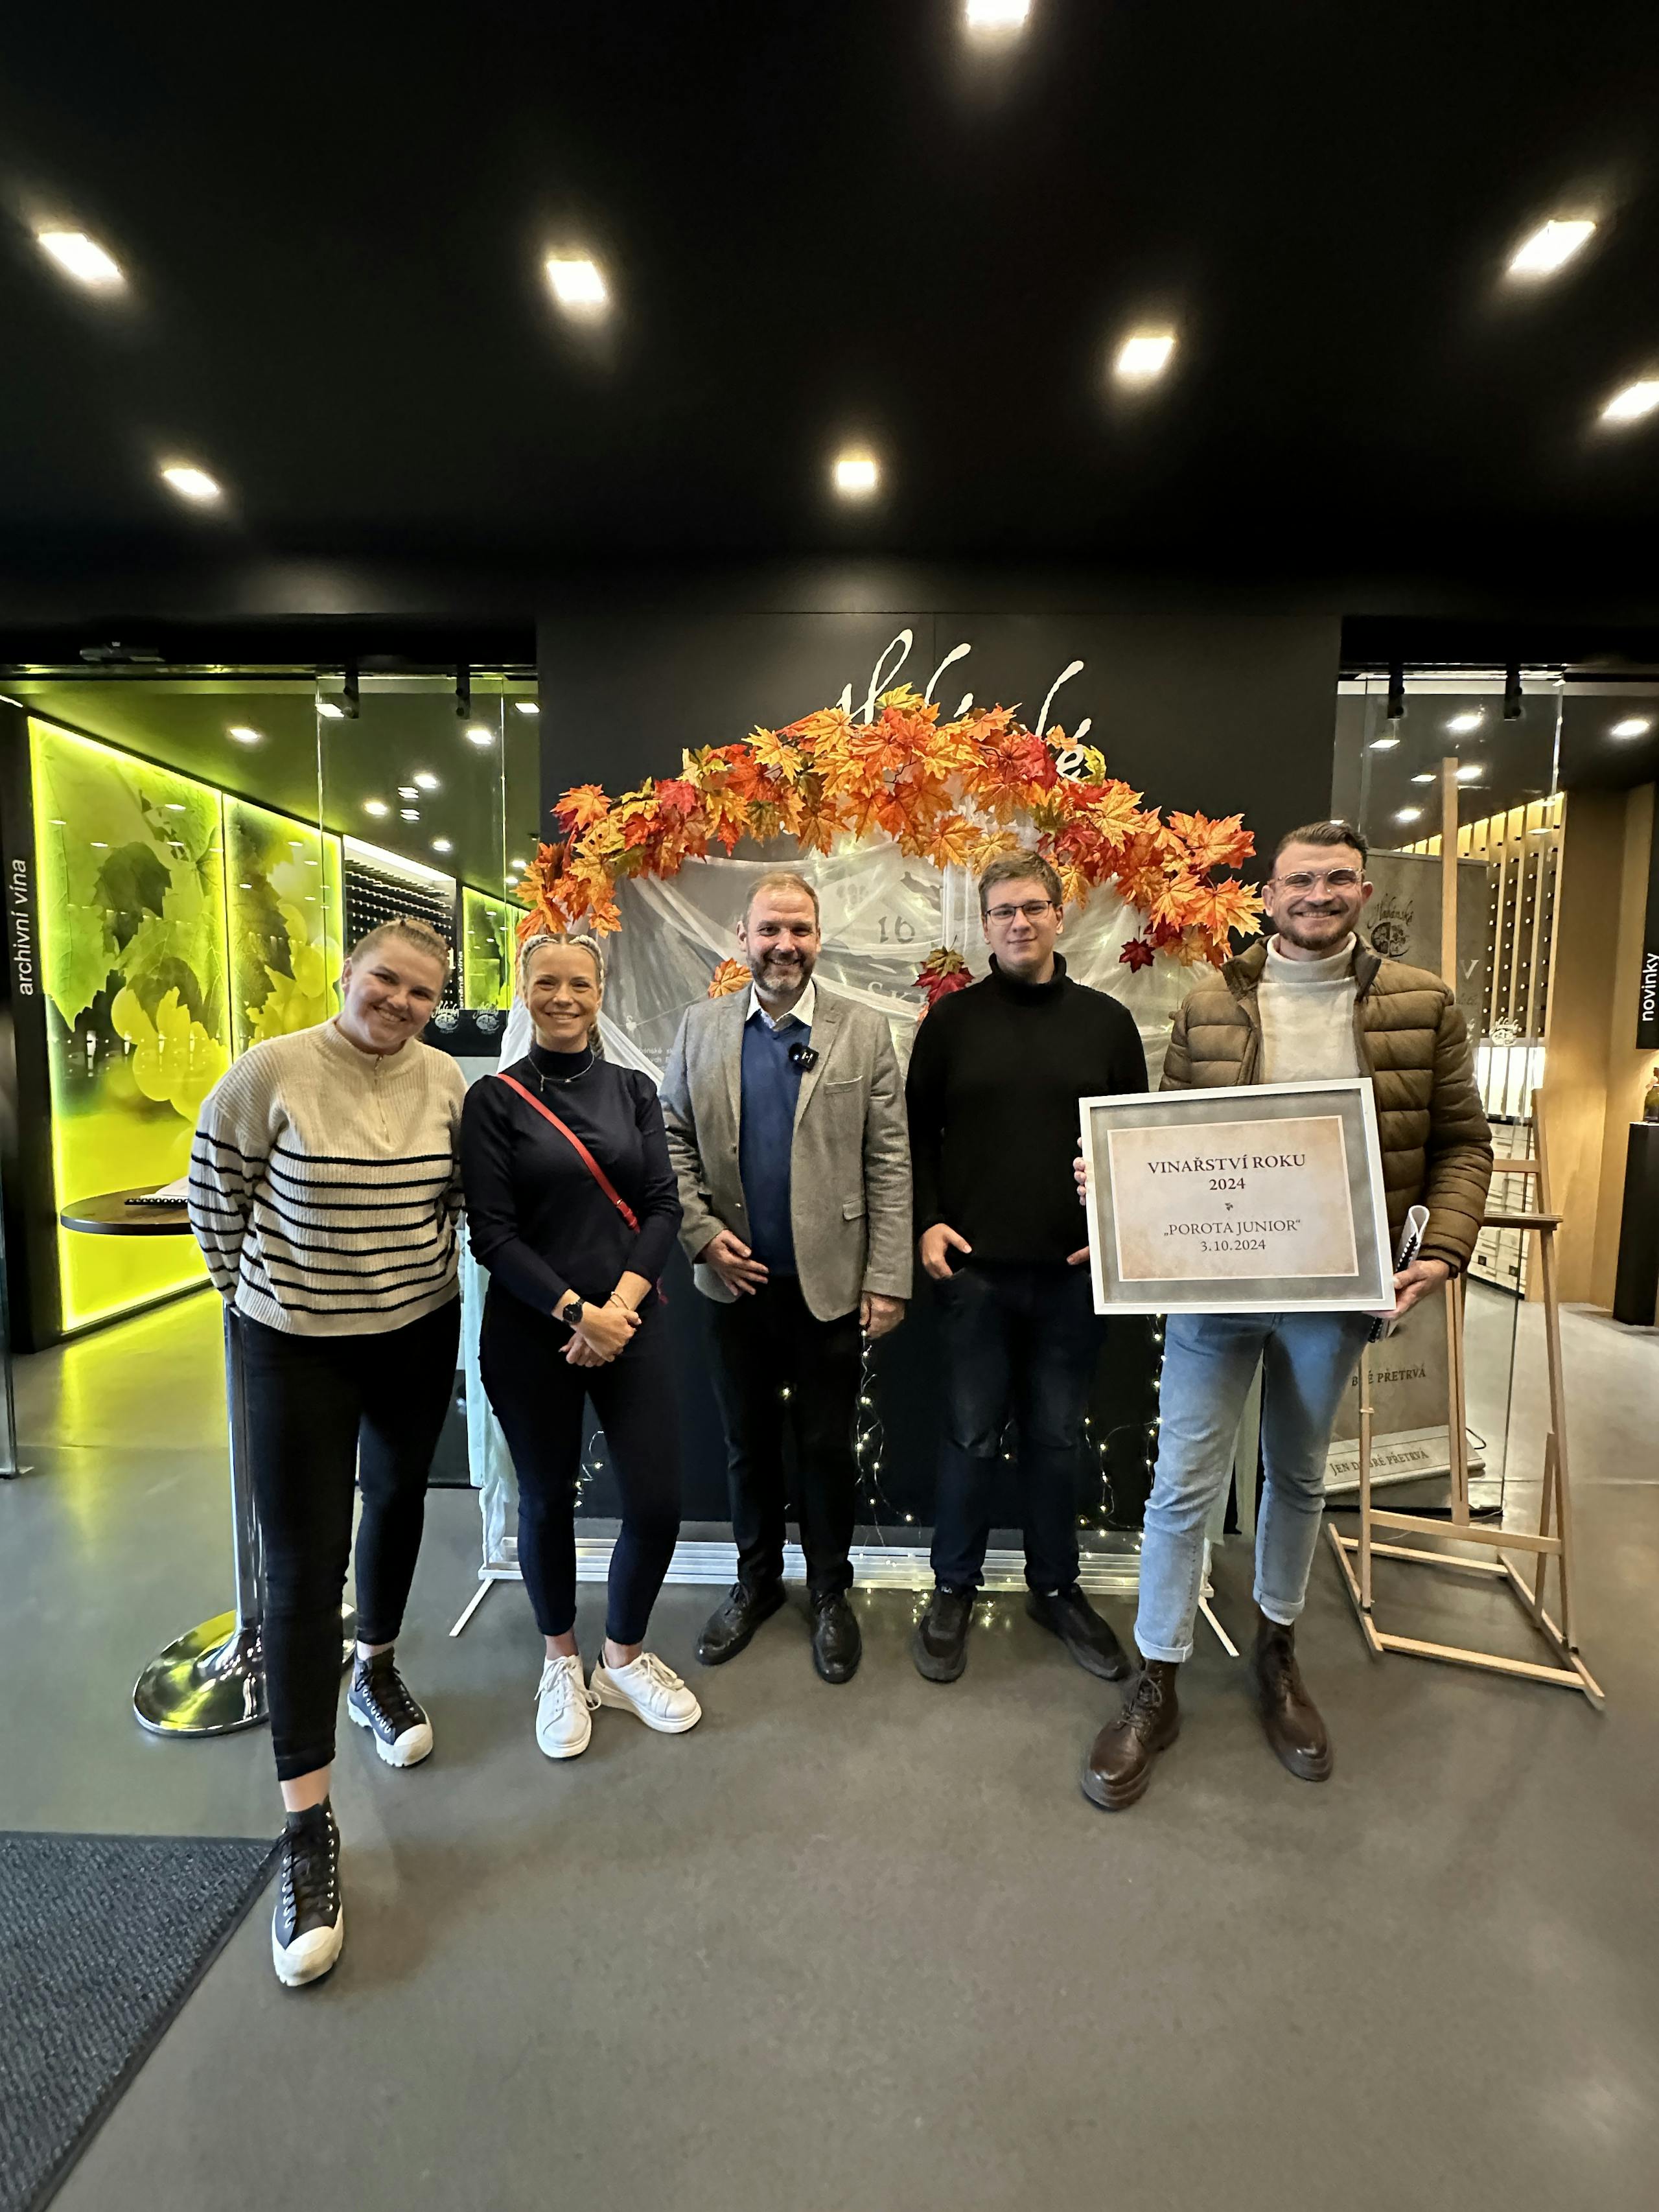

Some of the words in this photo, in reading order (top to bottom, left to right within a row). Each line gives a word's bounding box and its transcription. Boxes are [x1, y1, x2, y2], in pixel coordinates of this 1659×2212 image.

[9, 859, 29, 904] vína
[11, 911, 33, 995] archivní
[1641, 953, 1659, 1021] novinky
[1148, 1154, 1249, 1174] VINAŘSTVÍ
[1252, 1154, 1306, 1169] ROKU
[1209, 1177, 1246, 1191] 2024
[1200, 1239, 1266, 1252] 3.10.2024
[1377, 1364, 1426, 1383] PŘETRVÁ
[1329, 1461, 1350, 1476] JEN
[1386, 1447, 1430, 1465] PŘETRVÁ
